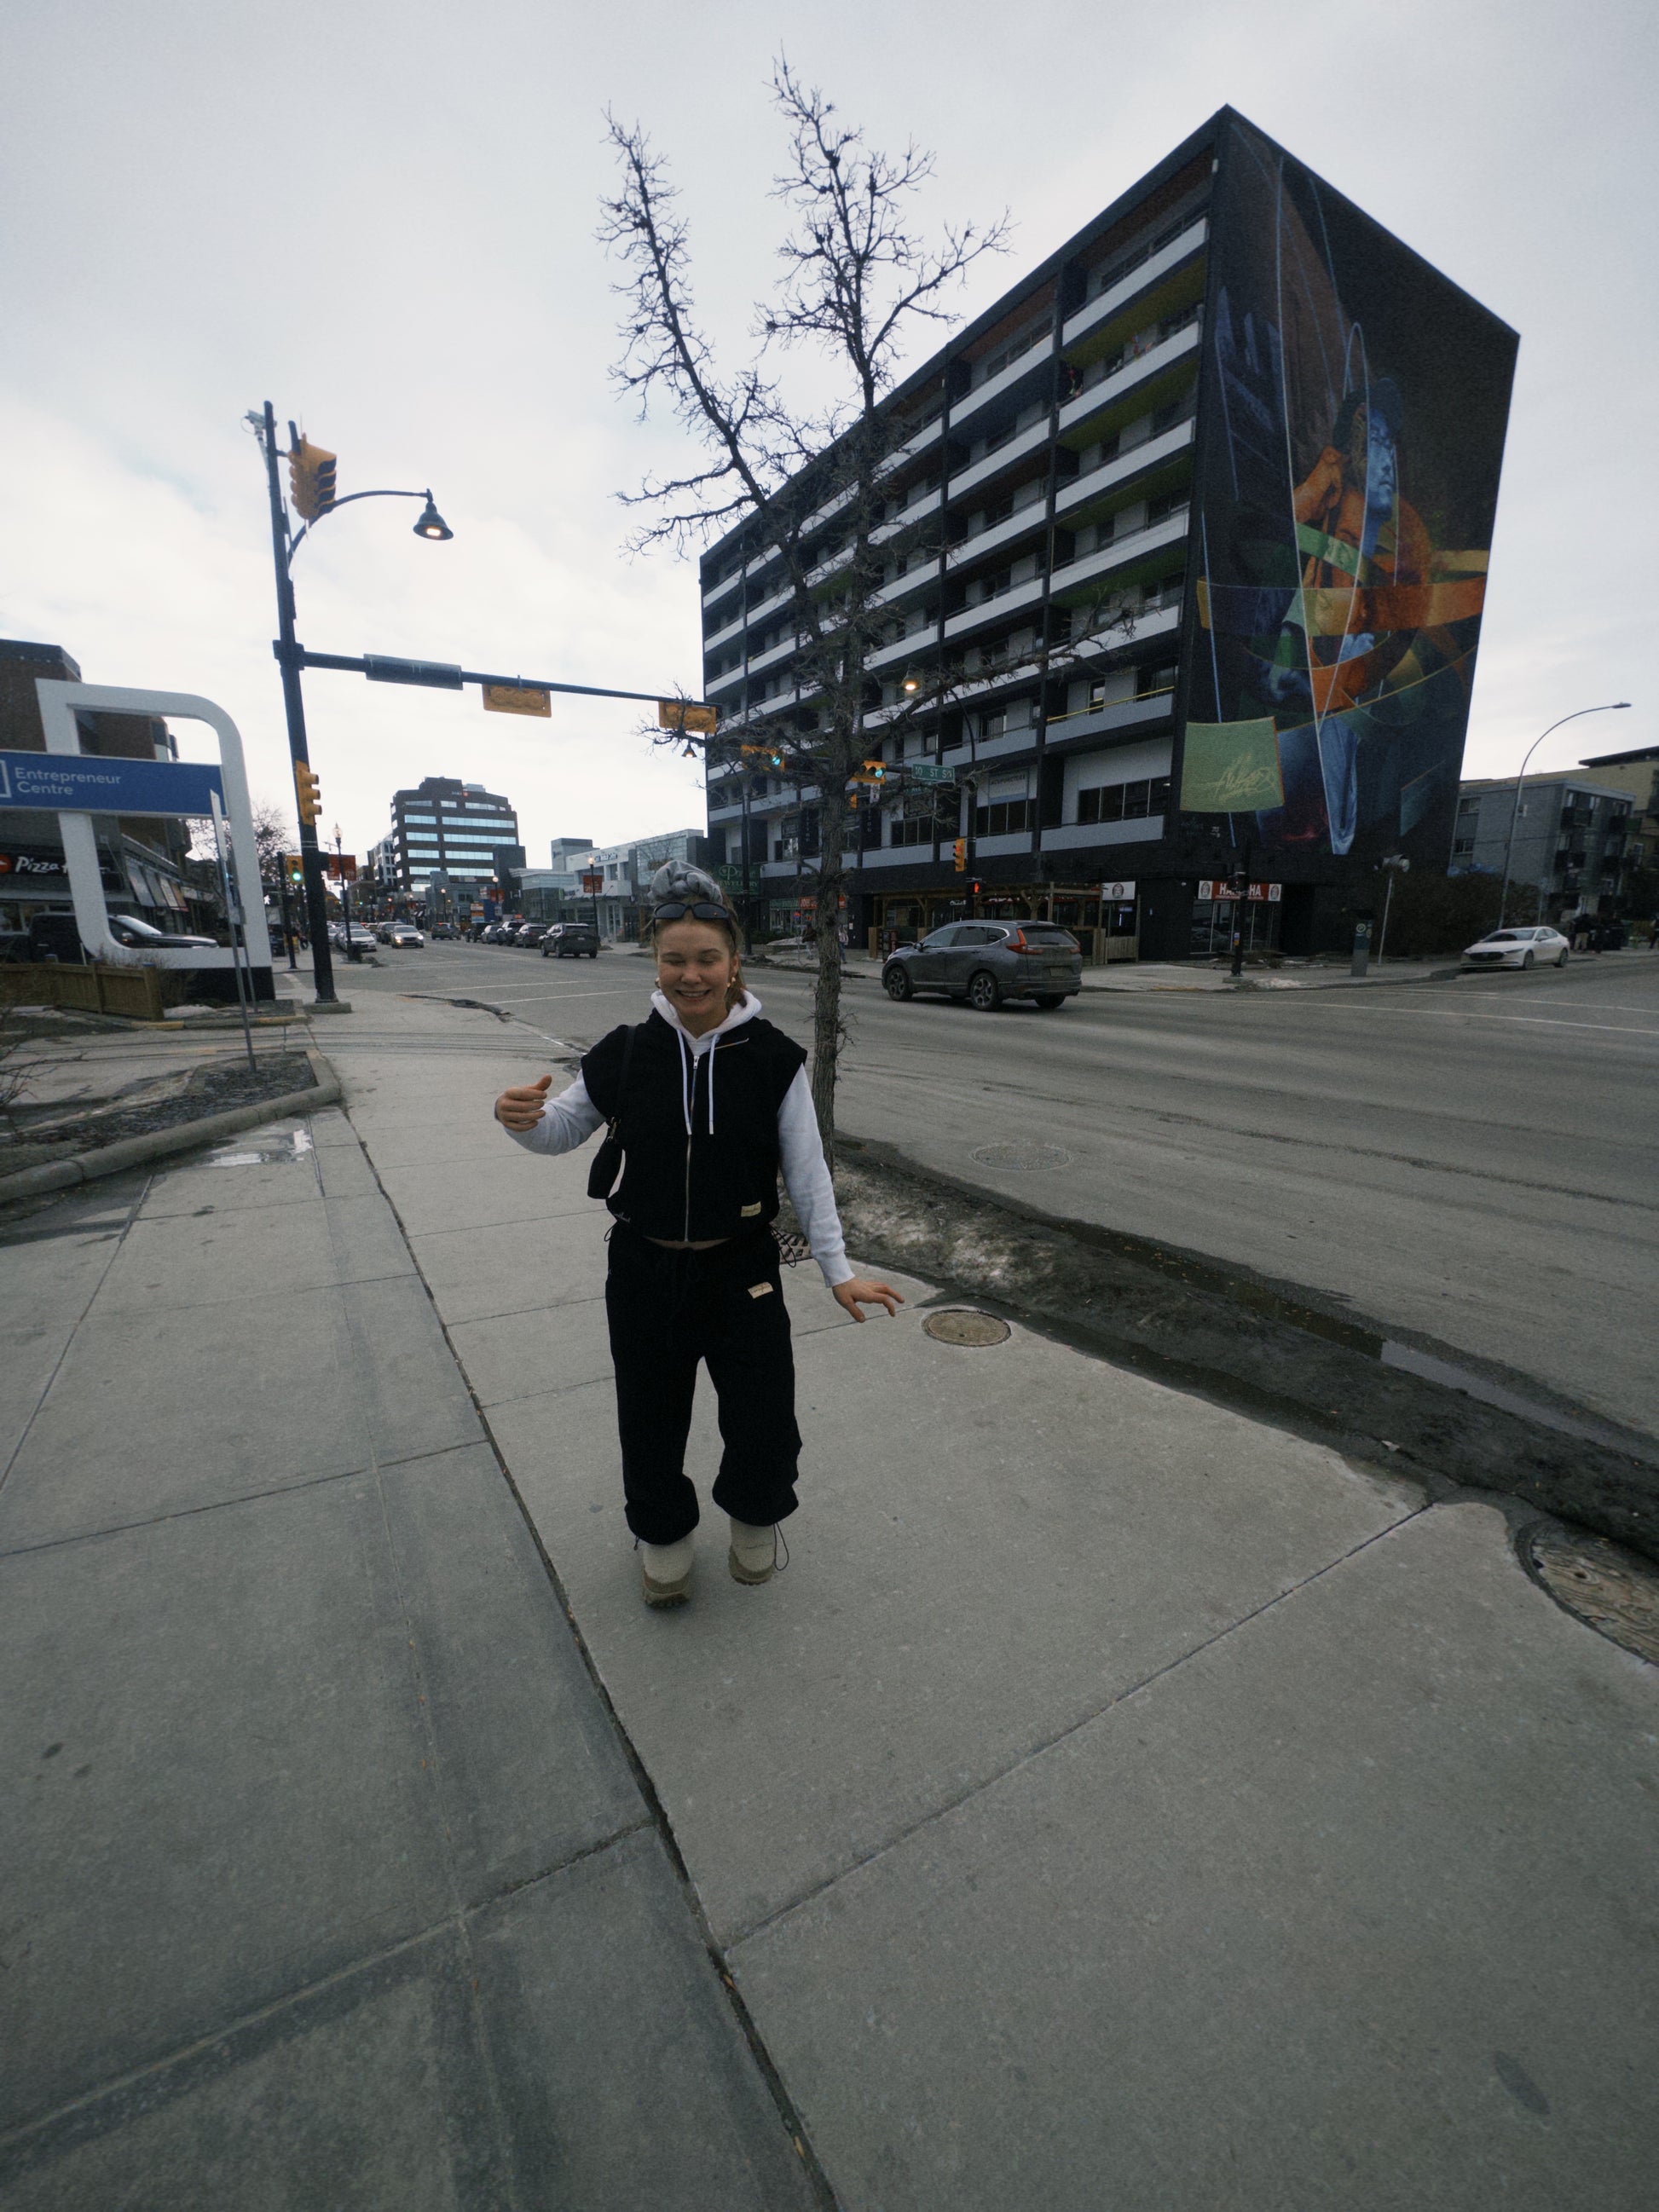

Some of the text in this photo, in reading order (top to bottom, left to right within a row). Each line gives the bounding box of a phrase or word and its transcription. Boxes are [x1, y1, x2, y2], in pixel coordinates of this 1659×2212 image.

[14, 767, 121, 783] Entrepreneur
[929, 768, 939, 777] ST
[17, 781, 73, 794] Centre
[15, 856, 60, 873] Pizza
